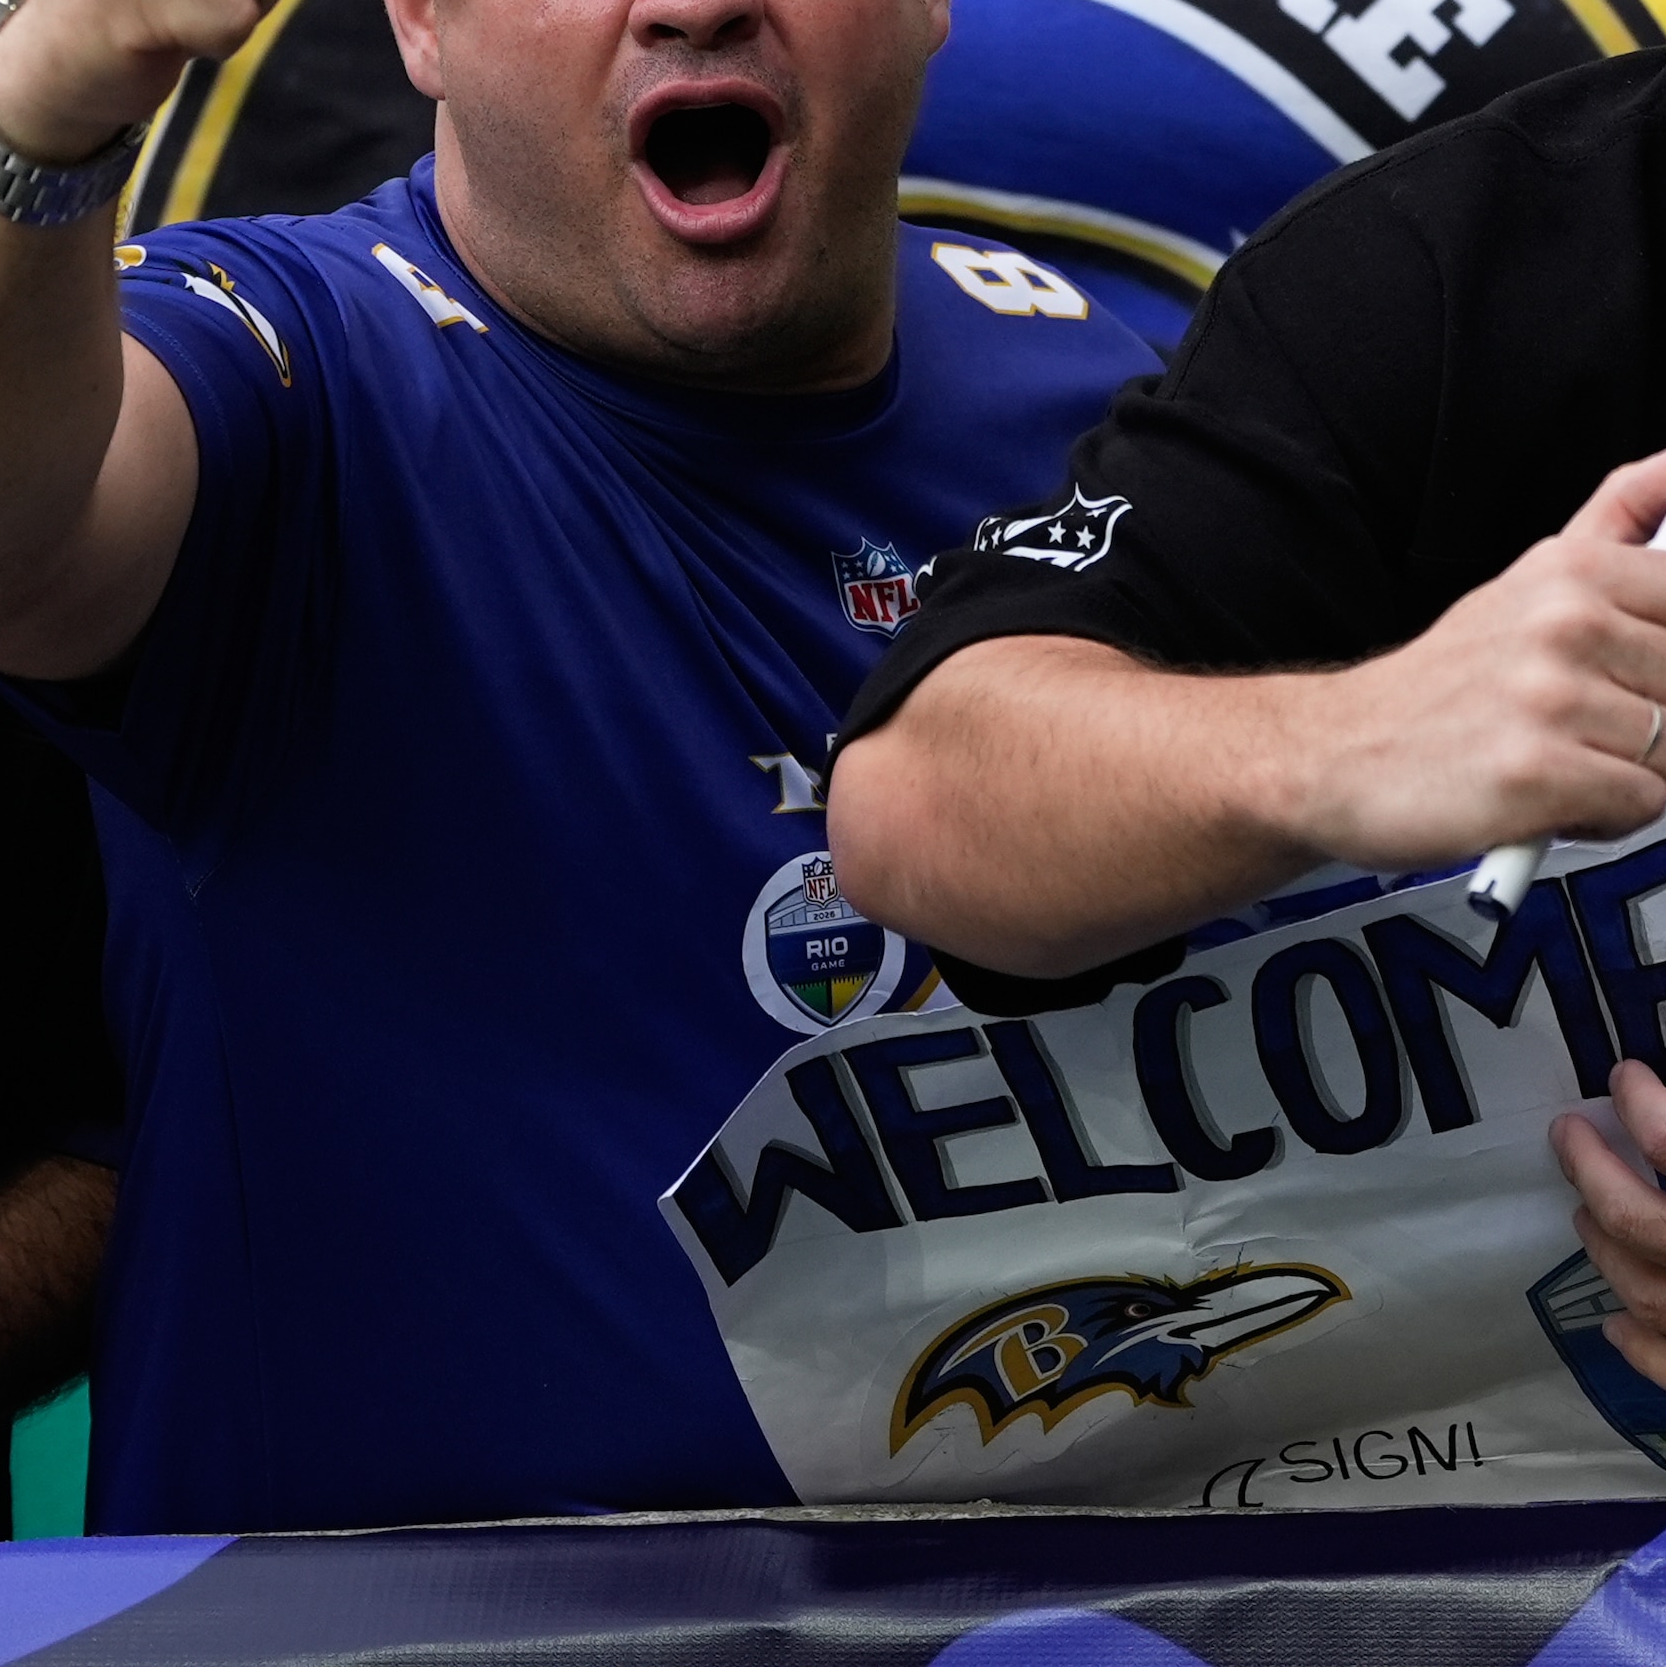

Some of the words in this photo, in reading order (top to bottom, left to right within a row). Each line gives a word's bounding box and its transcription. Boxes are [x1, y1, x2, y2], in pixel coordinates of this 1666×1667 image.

[930, 241, 1090, 321] 8
[848, 572, 922, 625] NFL
[806, 876, 837, 899] NFL
[806, 935, 849, 960] RIO
[810, 958, 847, 972] GAME
[1278, 1421, 1485, 1483] SIGN!
